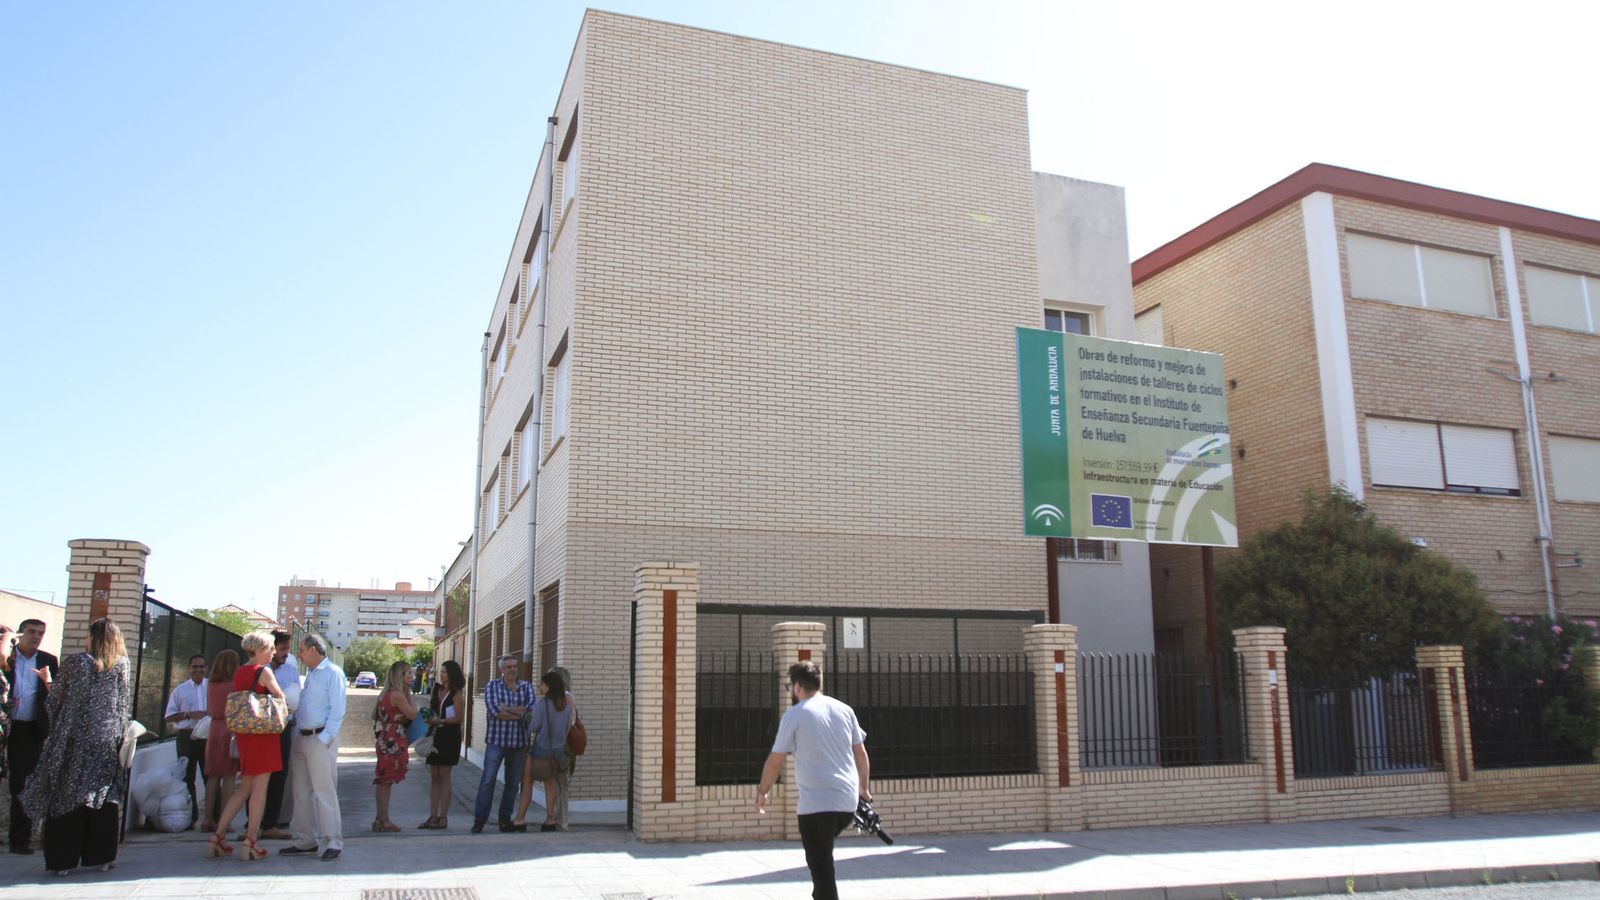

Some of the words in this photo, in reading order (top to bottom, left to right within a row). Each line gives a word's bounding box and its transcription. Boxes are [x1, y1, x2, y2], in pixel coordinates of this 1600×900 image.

[1048, 346, 1058, 391] ANDALUCIA
[1078, 347, 1104, 361] Obras
[1107, 350, 1118, 364] de
[1120, 353, 1156, 368] reforma
[1158, 361, 1162, 372] y
[1165, 361, 1194, 374] mejora
[1196, 364, 1206, 375] de
[1080, 367, 1138, 386] instalaciones
[1141, 374, 1150, 386] de
[1153, 376, 1185, 392] talleres
[1188, 382, 1198, 393] de
[1200, 382, 1223, 396] ciclos
[1050, 395, 1060, 404] DE
[1080, 389, 1127, 403] formativos
[1130, 395, 1140, 404] en
[1144, 394, 1150, 406] el
[1154, 395, 1188, 411] Instituto
[1192, 401, 1201, 412] de
[1050, 409, 1060, 436] JUNTA
[1081, 406, 1129, 423] Enseñanza
[1132, 412, 1180, 429] Secundaria
[1183, 418, 1230, 435] Fuentepiña
[1082, 426, 1094, 439] de
[1096, 427, 1126, 442] Huelva
[1083, 471, 1138, 484] Infraestructura
[1150, 478, 1178, 488] materia
[1178, 480, 1187, 489] de
[1188, 480, 1224, 491] Educación
